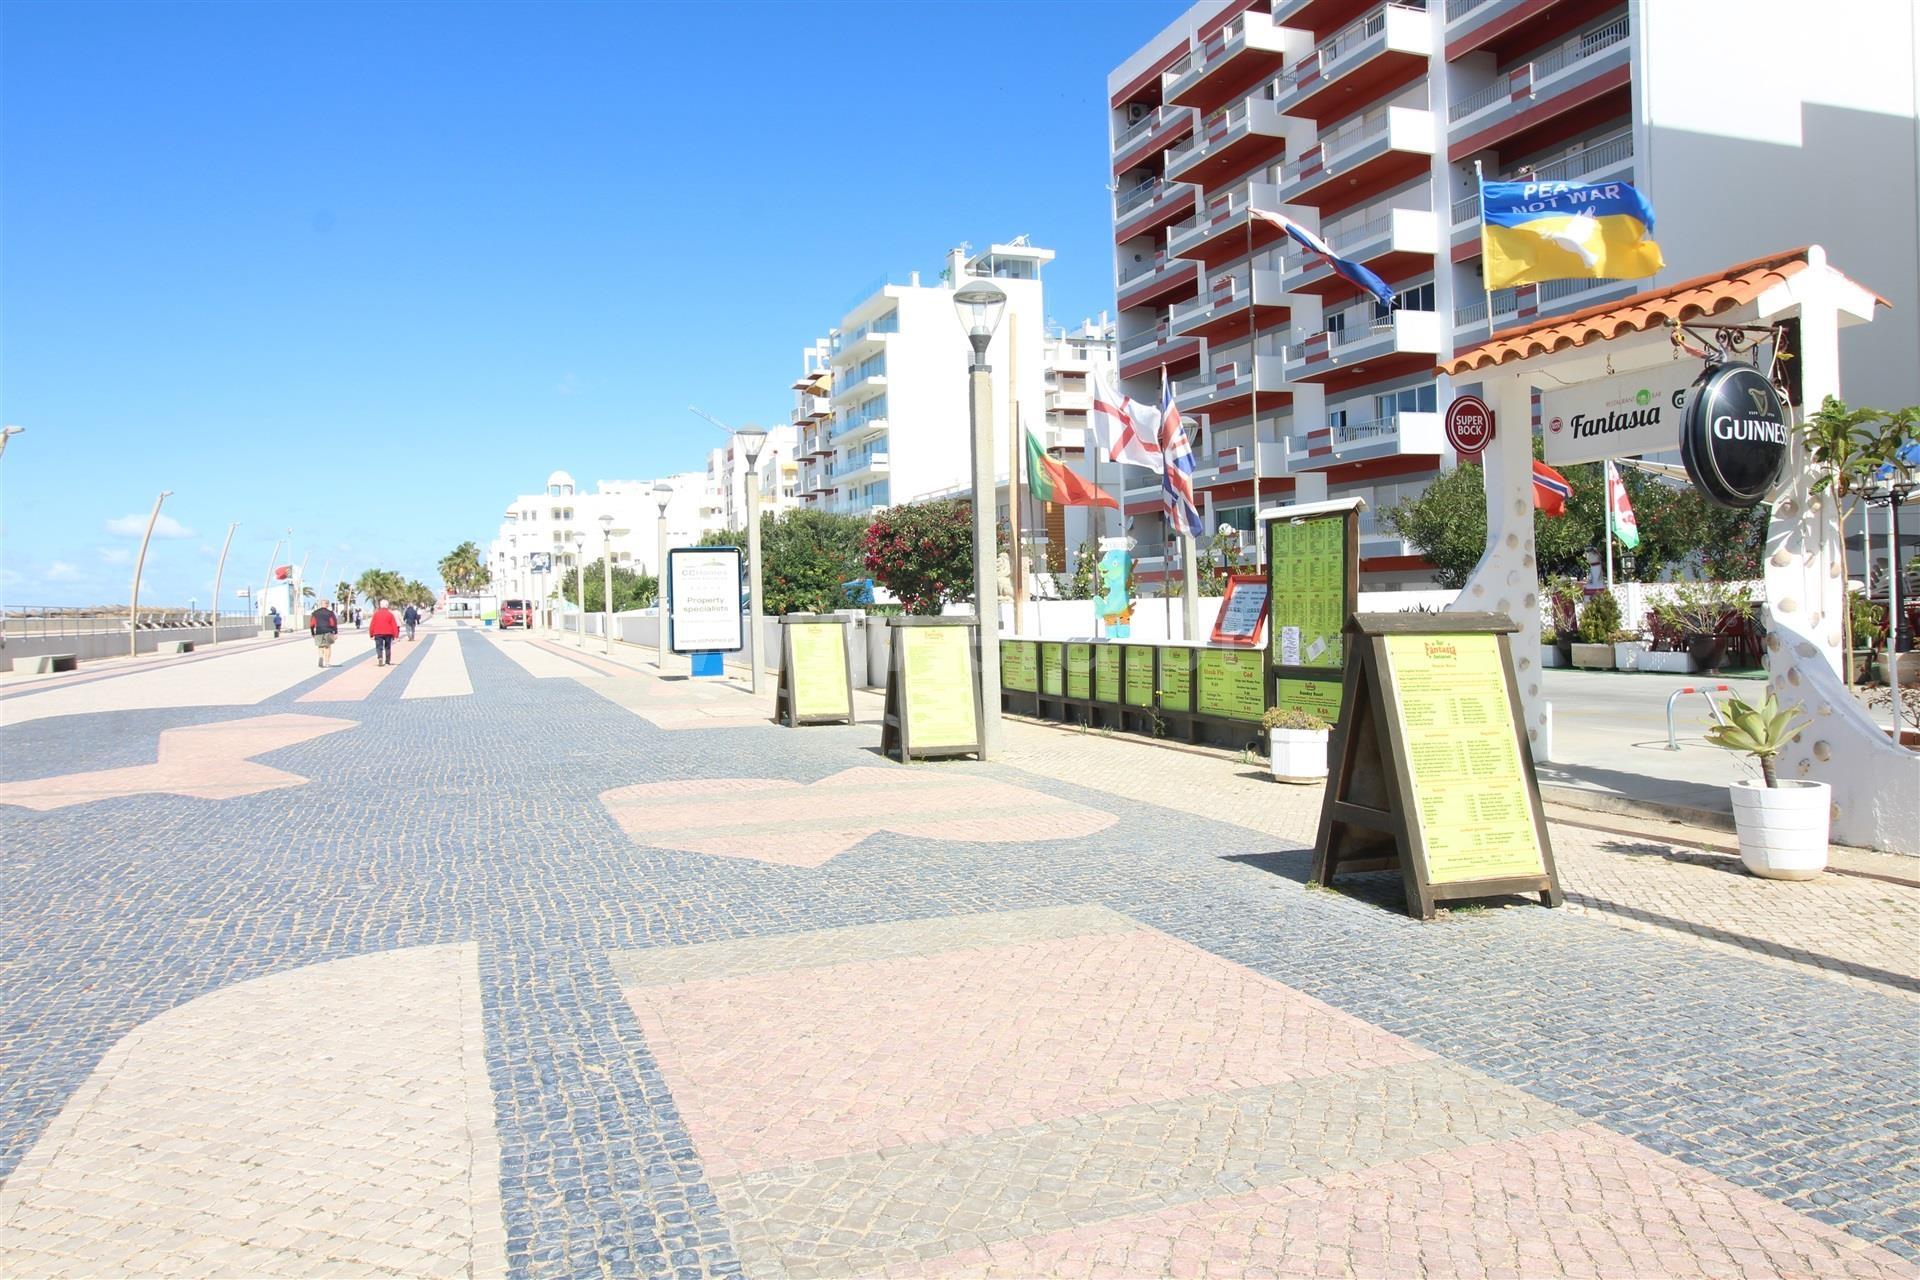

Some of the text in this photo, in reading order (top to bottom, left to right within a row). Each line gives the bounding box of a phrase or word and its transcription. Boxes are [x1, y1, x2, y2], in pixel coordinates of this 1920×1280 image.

[1511, 185, 1621, 214] NOT WAR
[1456, 415, 1483, 425] SUPER
[1570, 406, 1661, 439] Fantasia
[1458, 425, 1482, 435] BOCK
